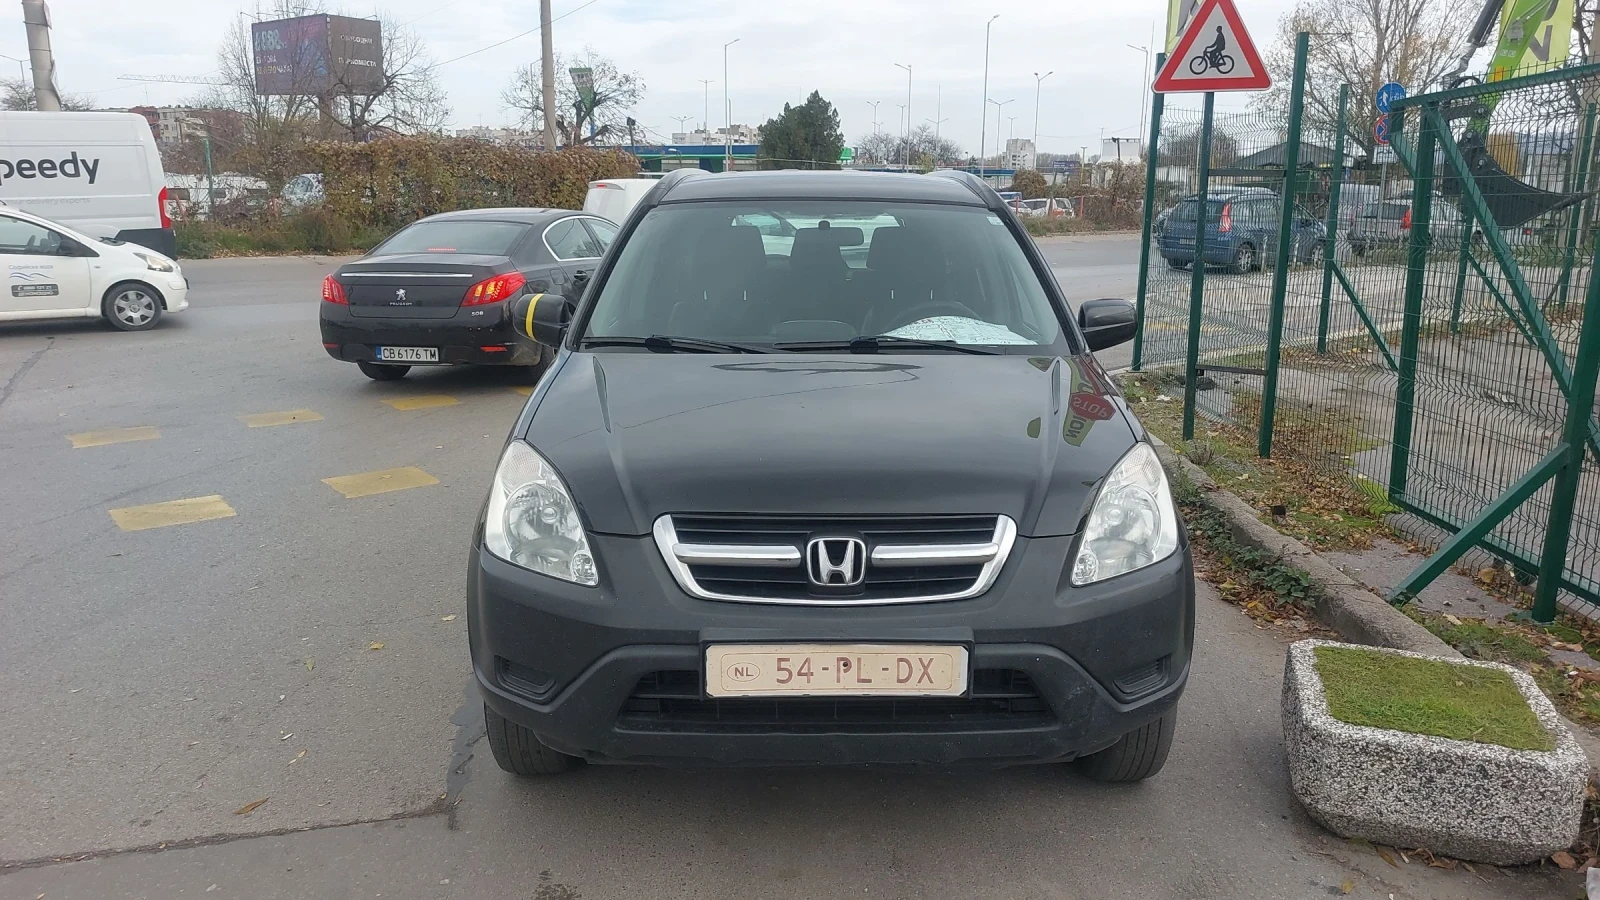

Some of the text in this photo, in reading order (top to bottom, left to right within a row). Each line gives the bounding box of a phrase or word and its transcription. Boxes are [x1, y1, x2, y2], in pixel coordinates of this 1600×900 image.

[26, 198, 59, 206] delivery
[60, 197, 91, 205] experts
[382, 348, 437, 360] CB 6176 TM
[734, 667, 754, 678] NL
[776, 656, 935, 685] 54-PL-DX
